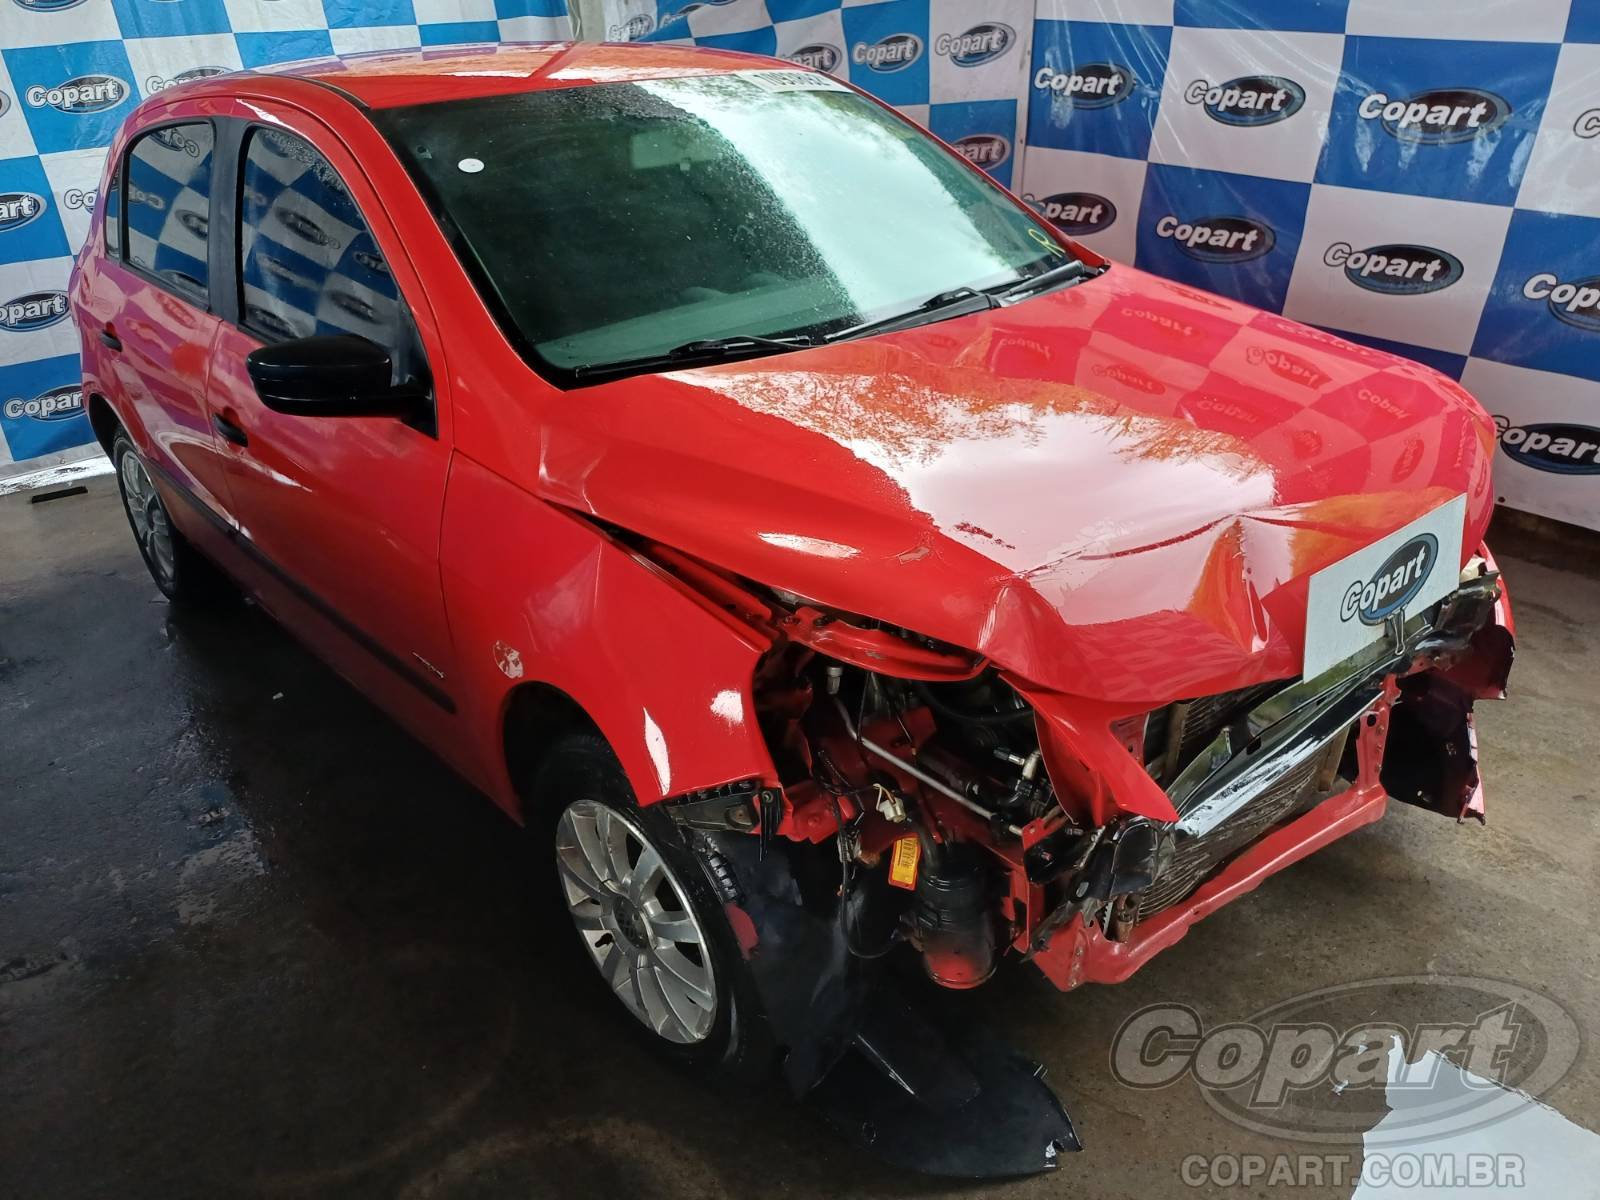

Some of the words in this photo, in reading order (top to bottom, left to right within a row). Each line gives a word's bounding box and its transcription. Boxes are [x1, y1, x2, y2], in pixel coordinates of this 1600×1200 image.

[853, 38, 914, 64] Copart
[935, 29, 1003, 57] Copart
[27, 79, 118, 108] Copart
[1034, 67, 1122, 96] Copart
[1184, 80, 1288, 111] Copart
[1358, 94, 1487, 128] Copart
[1156, 216, 1258, 251] Copart
[1324, 242, 1442, 282] Copart
[4, 392, 82, 419] Copar
[1340, 545, 1426, 623] Copart
